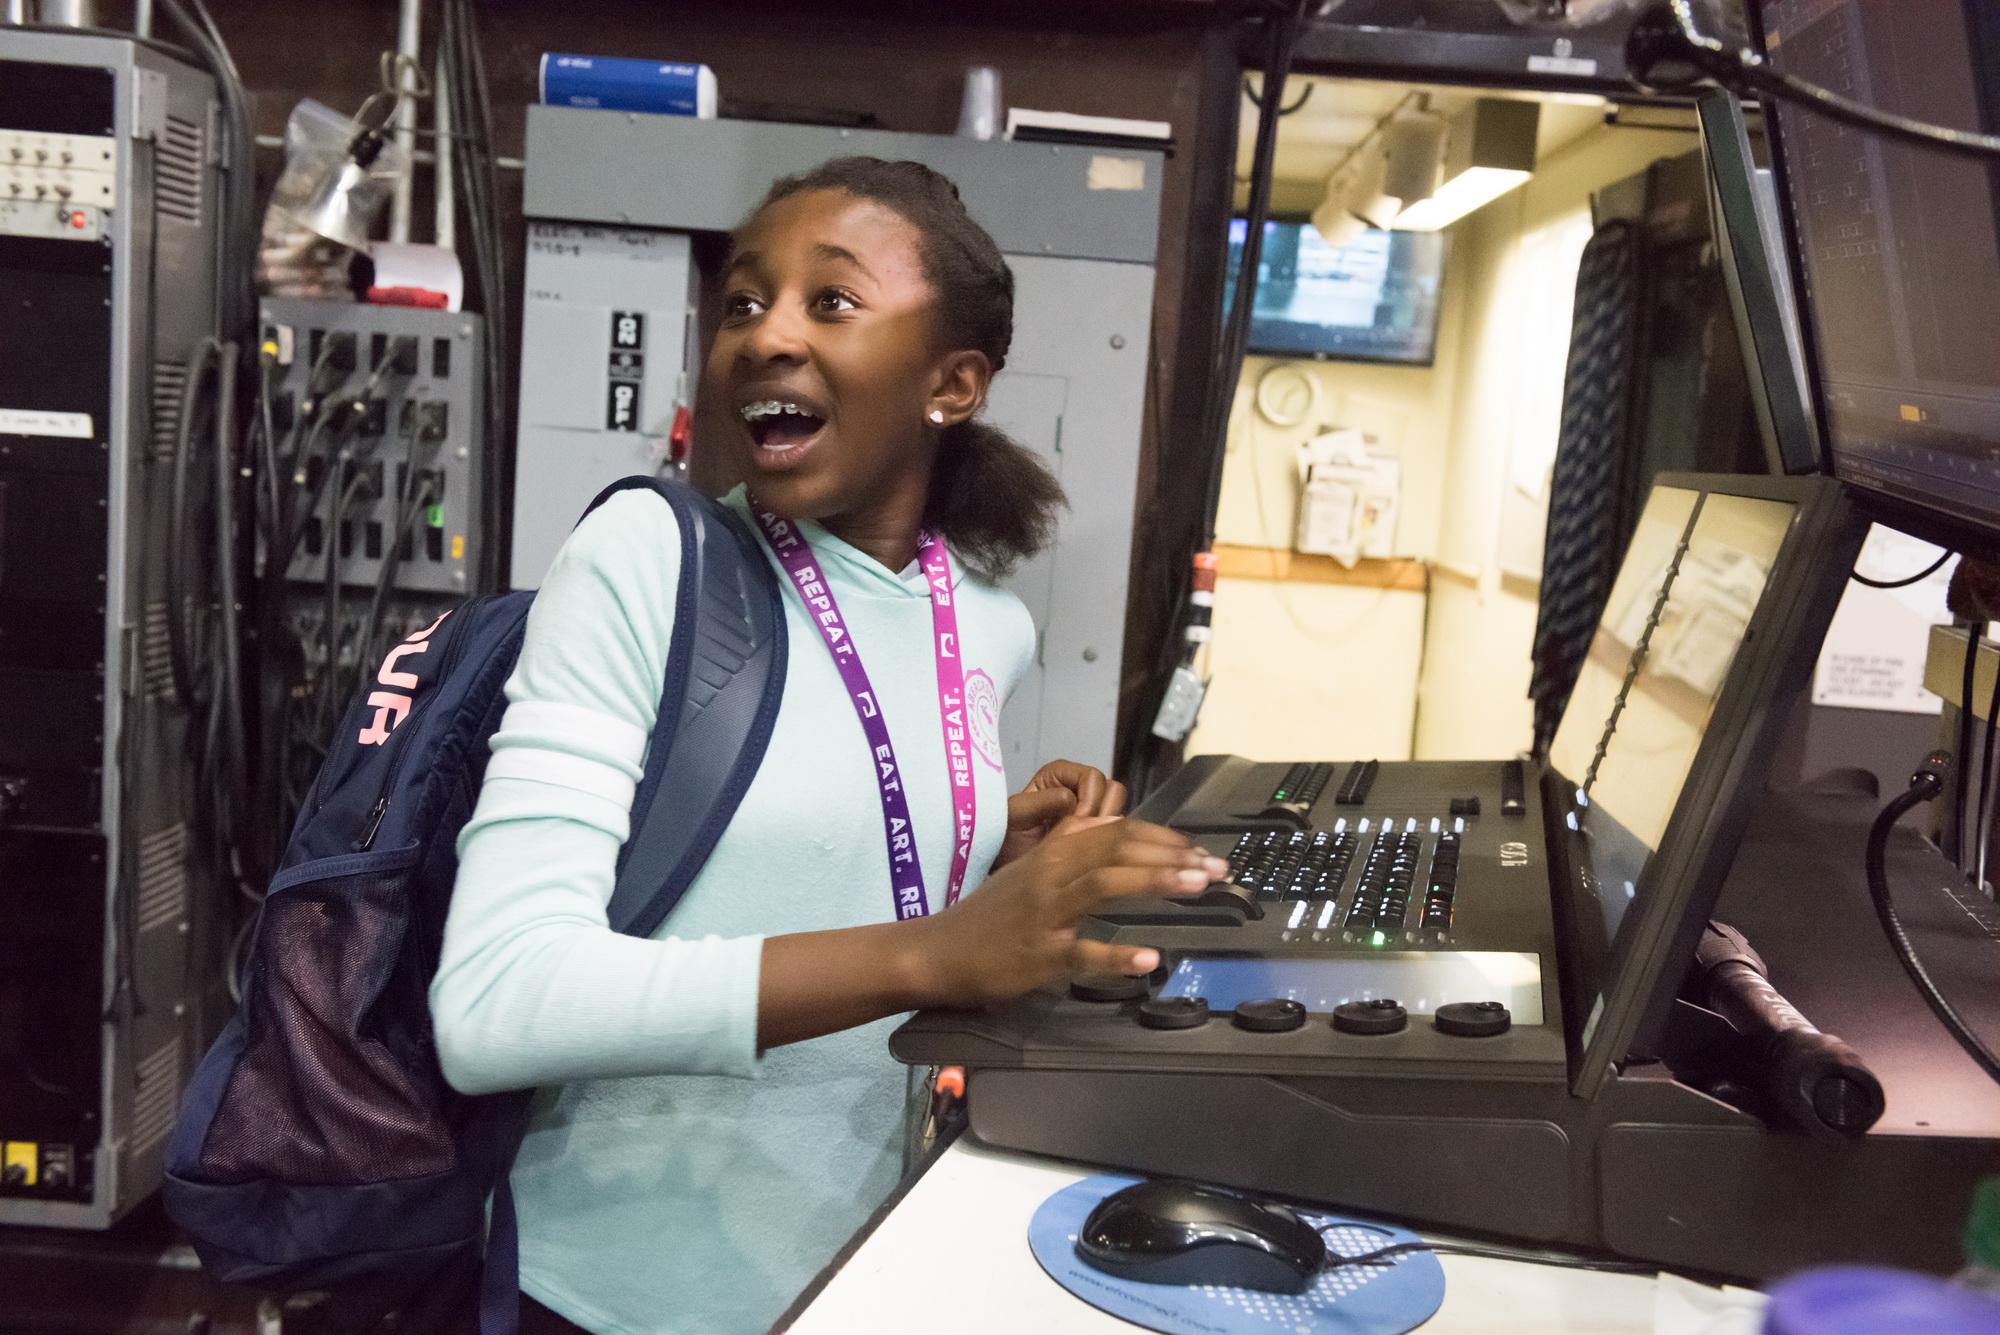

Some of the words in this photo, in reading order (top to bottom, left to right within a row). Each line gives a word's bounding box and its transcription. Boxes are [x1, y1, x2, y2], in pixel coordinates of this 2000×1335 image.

[926, 555, 951, 607] EAT.
[794, 565, 854, 665] REPEAT.
[943, 687, 970, 787] REPEAT.
[875, 743, 900, 802] EAT.
[890, 817, 913, 873] ART.
[958, 802, 972, 860] ART.
[899, 885, 923, 920] RE
